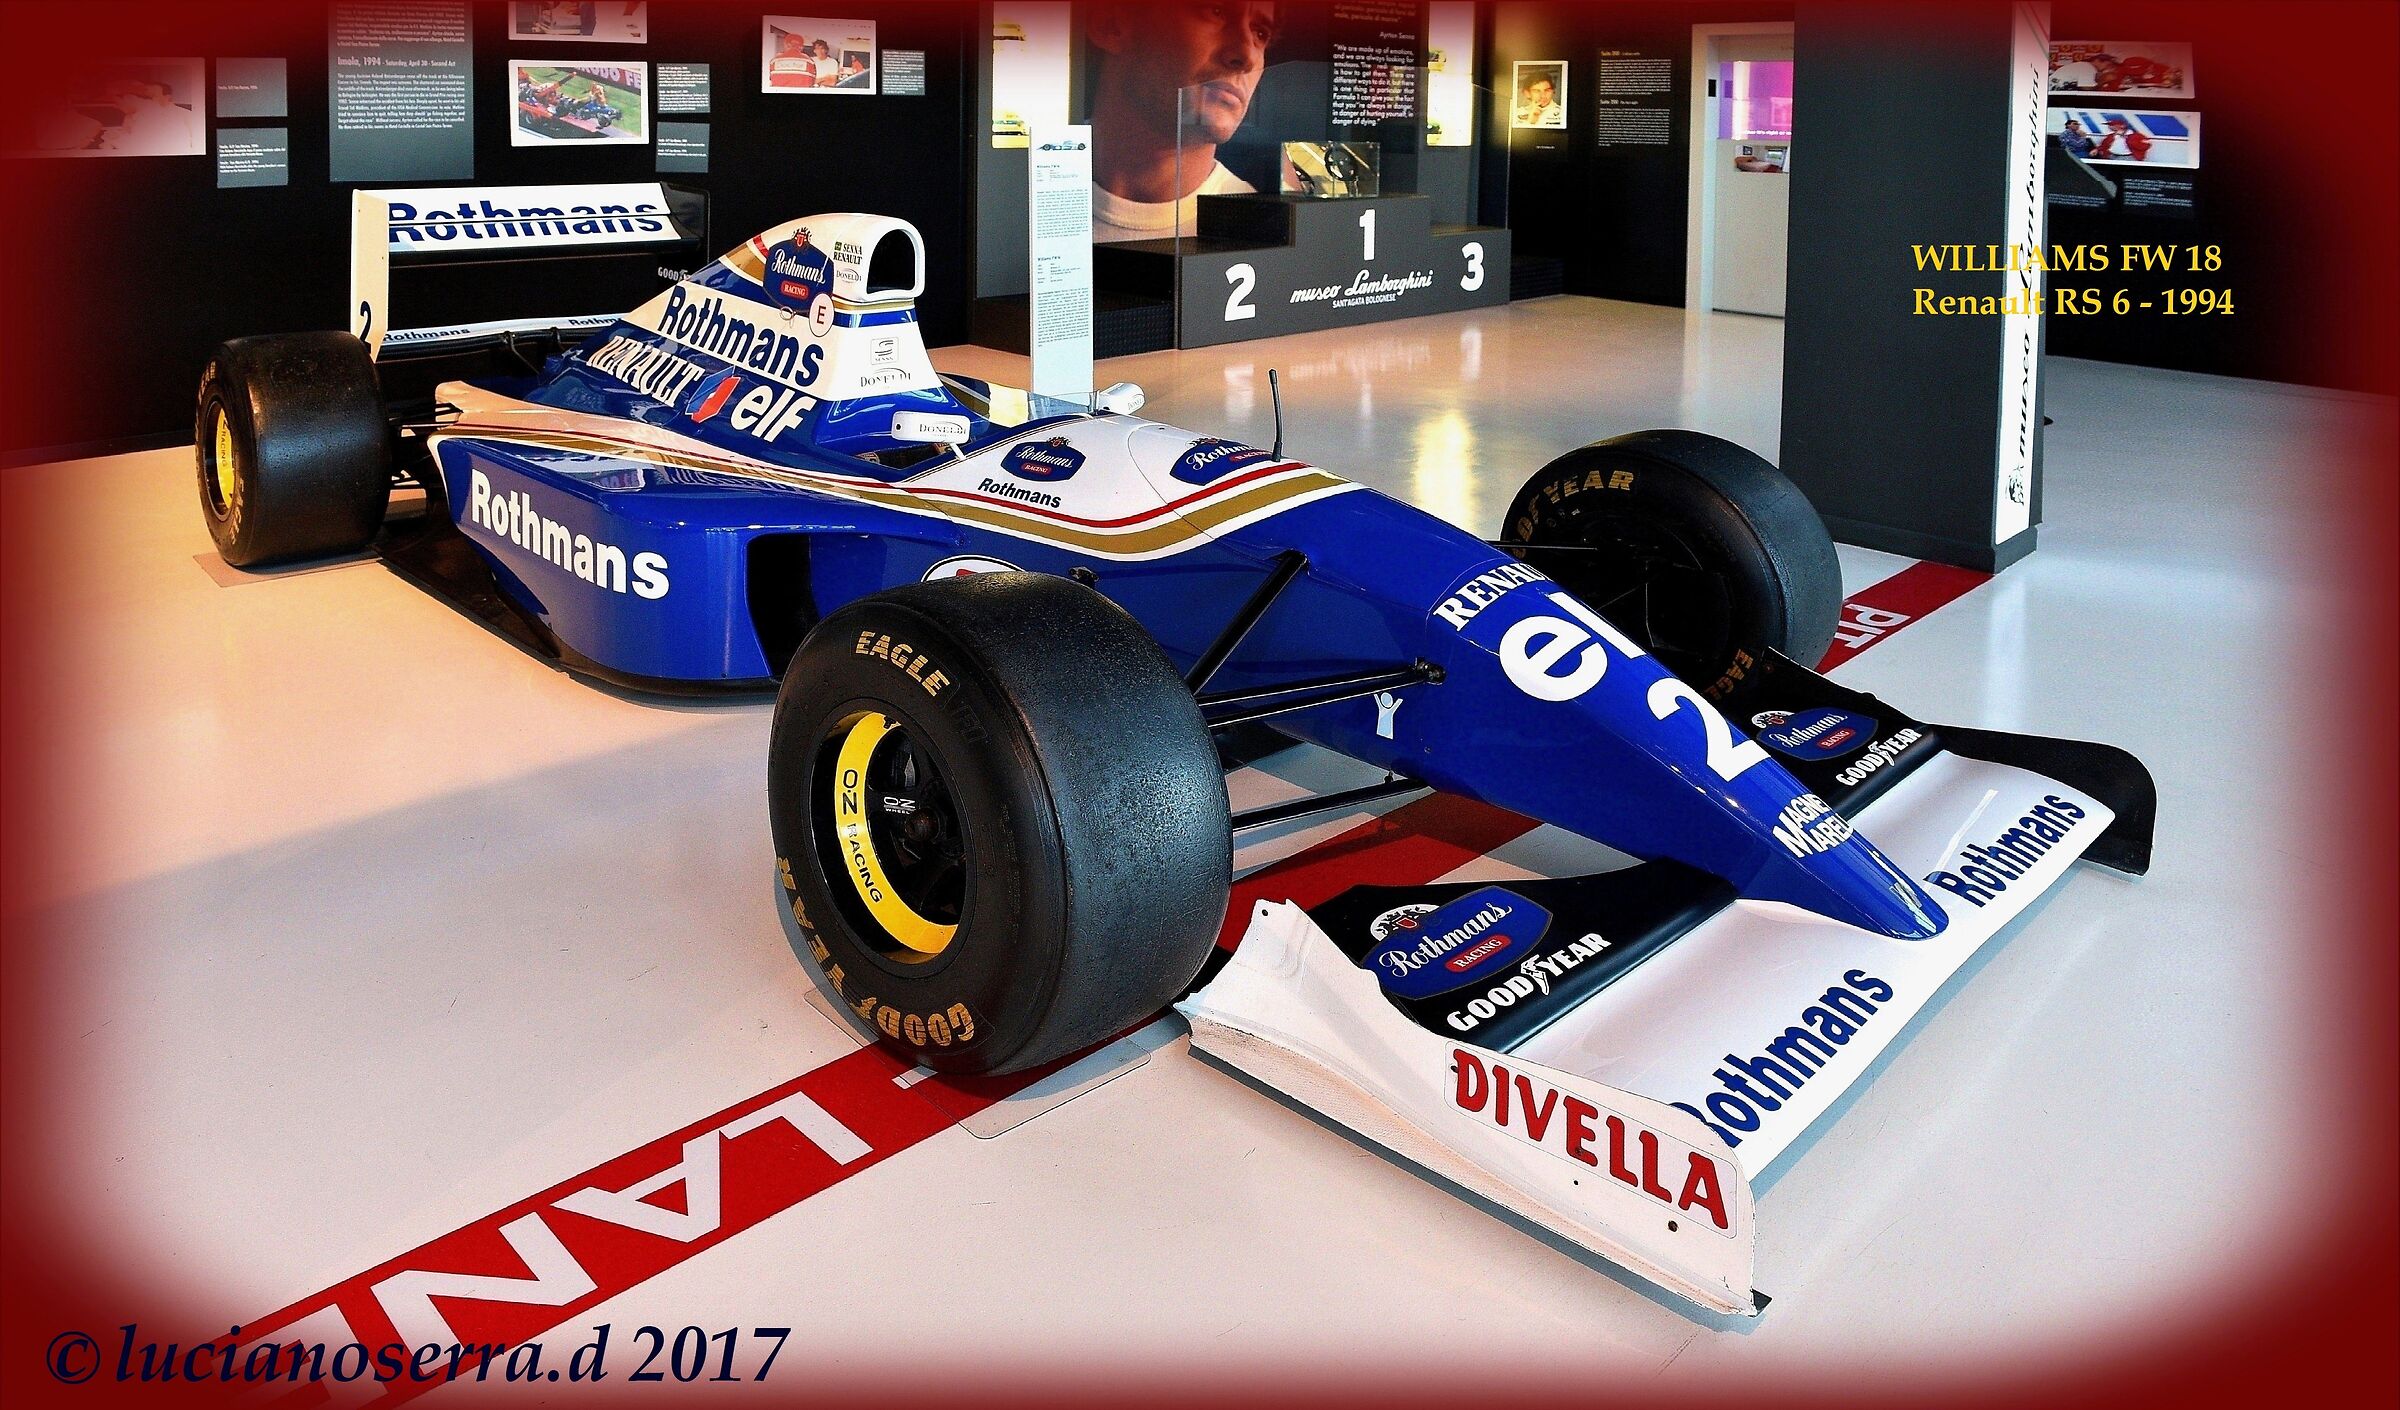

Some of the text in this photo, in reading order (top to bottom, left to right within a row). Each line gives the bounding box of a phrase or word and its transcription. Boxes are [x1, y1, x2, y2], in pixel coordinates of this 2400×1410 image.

[1379, 31, 1415, 40] Ayrton Senna
[363, 56, 381, 67] 1994
[1333, 52, 1345, 60] and
[1366, 53, 1385, 63] always
[1353, 85, 1368, 94] thing
[1366, 102, 1386, 110] always
[1332, 117, 1353, 126] danger
[1339, 109, 1359, 118] danger
[1366, 110, 1385, 119] hurting
[388, 200, 664, 243] Rothmans
[1359, 208, 1376, 261] 1
[771, 248, 826, 284] Rothmans
[833, 251, 863, 265] RENAULT
[843, 243, 863, 255] SENNA
[1460, 241, 1485, 292] 3
[783, 284, 806, 297] RACING
[1224, 262, 1257, 322] 2
[1289, 269, 1434, 304] museo Lamborghini
[1365, 293, 1397, 305] BOLOGNESE
[359, 300, 373, 353] 2
[567, 316, 623, 329] Rothm
[816, 304, 827, 325] E
[384, 327, 471, 342] Rothmans
[656, 284, 825, 387] Rothmans
[586, 335, 706, 407] RENAULT
[2018, 328, 2033, 458] museo
[730, 383, 817, 443] elf
[1016, 445, 1075, 469] Rothmans
[1024, 464, 1049, 473] RACING
[1186, 444, 1259, 471] Rothm
[977, 477, 1062, 509] Rothmans
[471, 467, 671, 601] Rothmans
[1833, 603, 1912, 649] PIT
[855, 630, 951, 697] EAGLE
[1499, 591, 1648, 703] el
[1646, 677, 1772, 783] 2
[1769, 713, 1849, 748] Rothmans
[1820, 729, 1850, 748] RACING
[1835, 728, 1923, 787] GOODYEAR
[885, 807, 911, 815] WHEEL
[847, 822, 883, 904] RACING
[1924, 792, 2086, 908] Rothmans
[777, 856, 975, 1047] GOODYEAR
[1378, 901, 1513, 978] Rothmans
[1453, 938, 1503, 968] RACING
[1446, 932, 1612, 1032] GOODYEAR
[1453, 1048, 1729, 1230] DIVELLA
